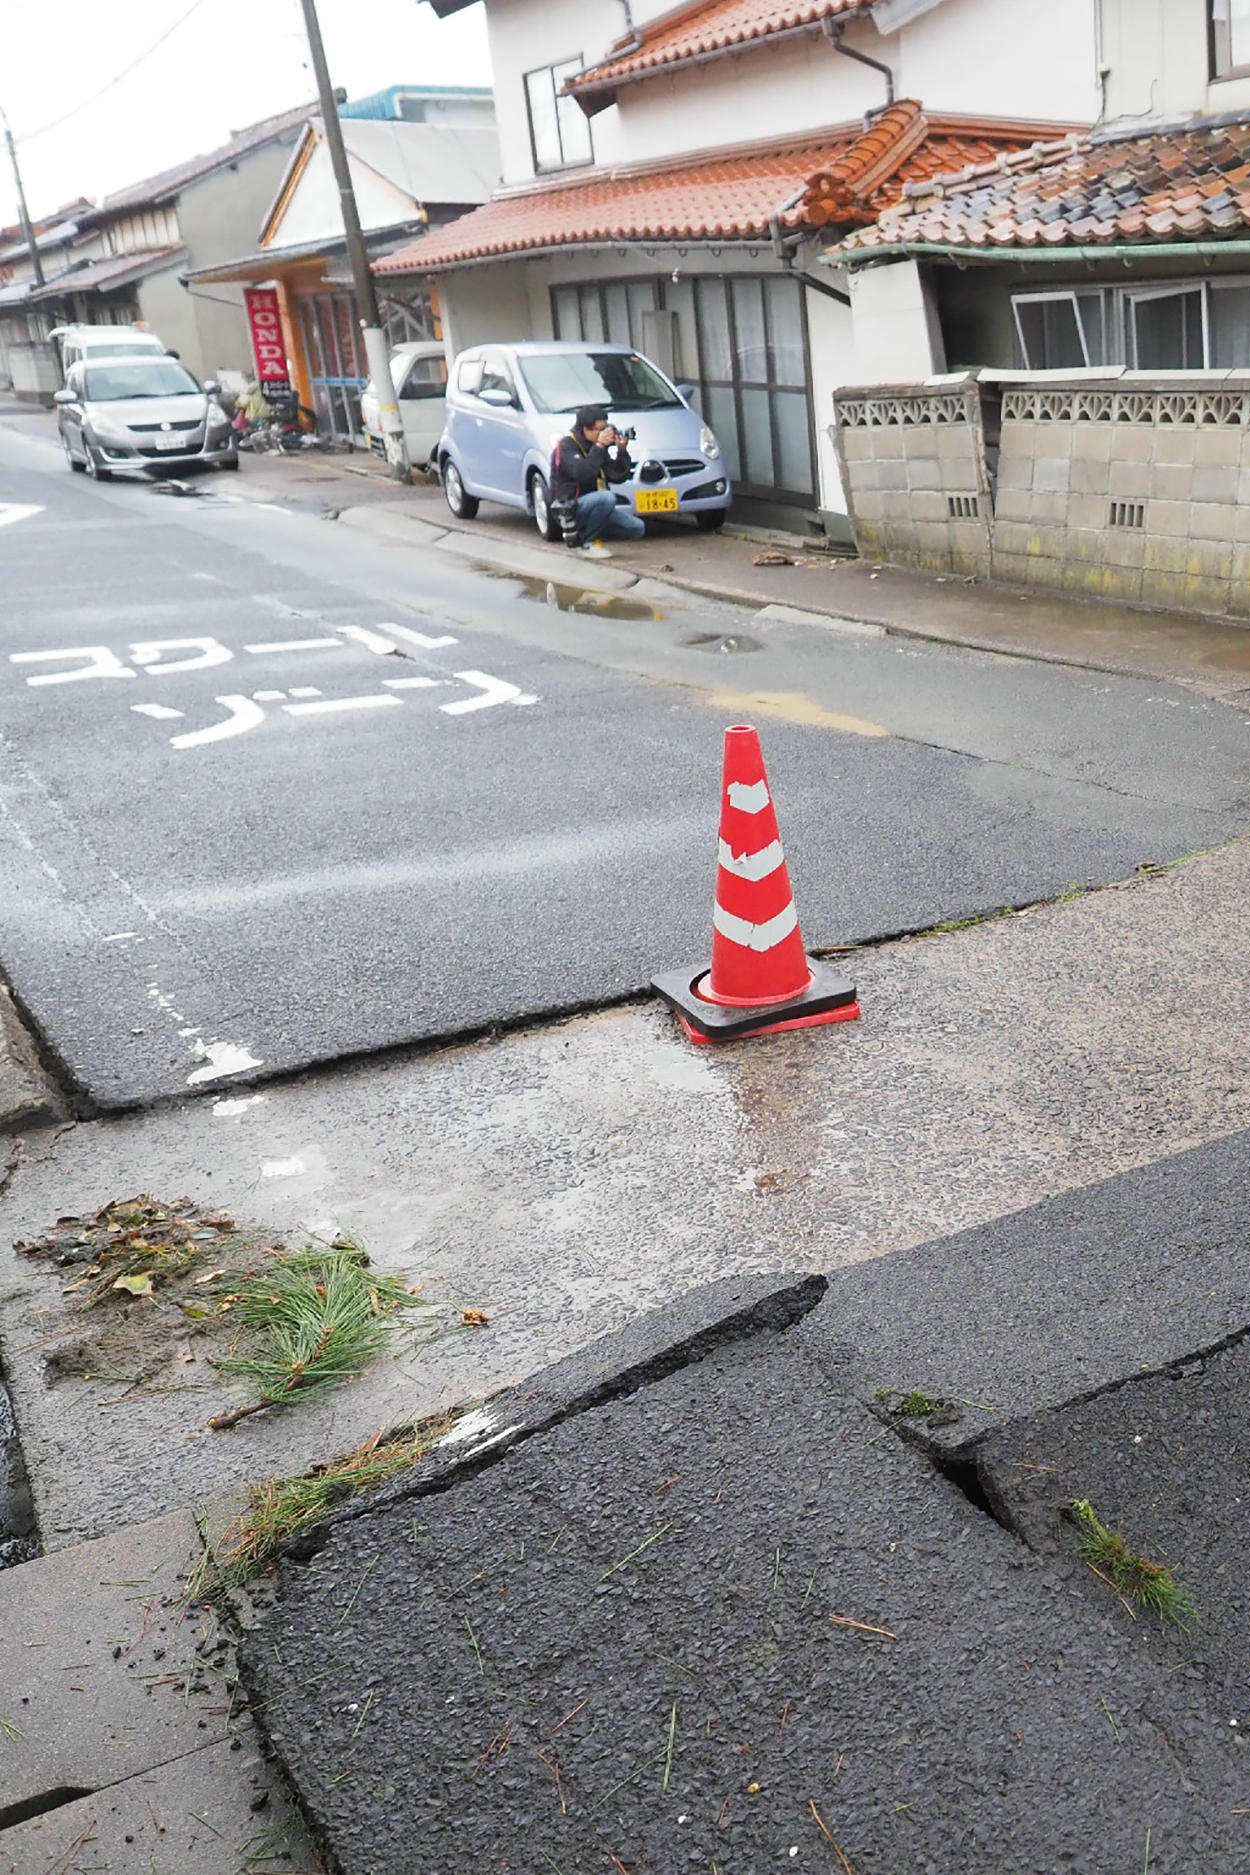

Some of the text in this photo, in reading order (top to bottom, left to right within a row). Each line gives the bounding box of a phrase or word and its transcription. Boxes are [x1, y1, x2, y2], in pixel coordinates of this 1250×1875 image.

[251, 295, 284, 375] HONDA
[9, 623, 459, 687] スクール
[130, 670, 541, 749] ゾーン
